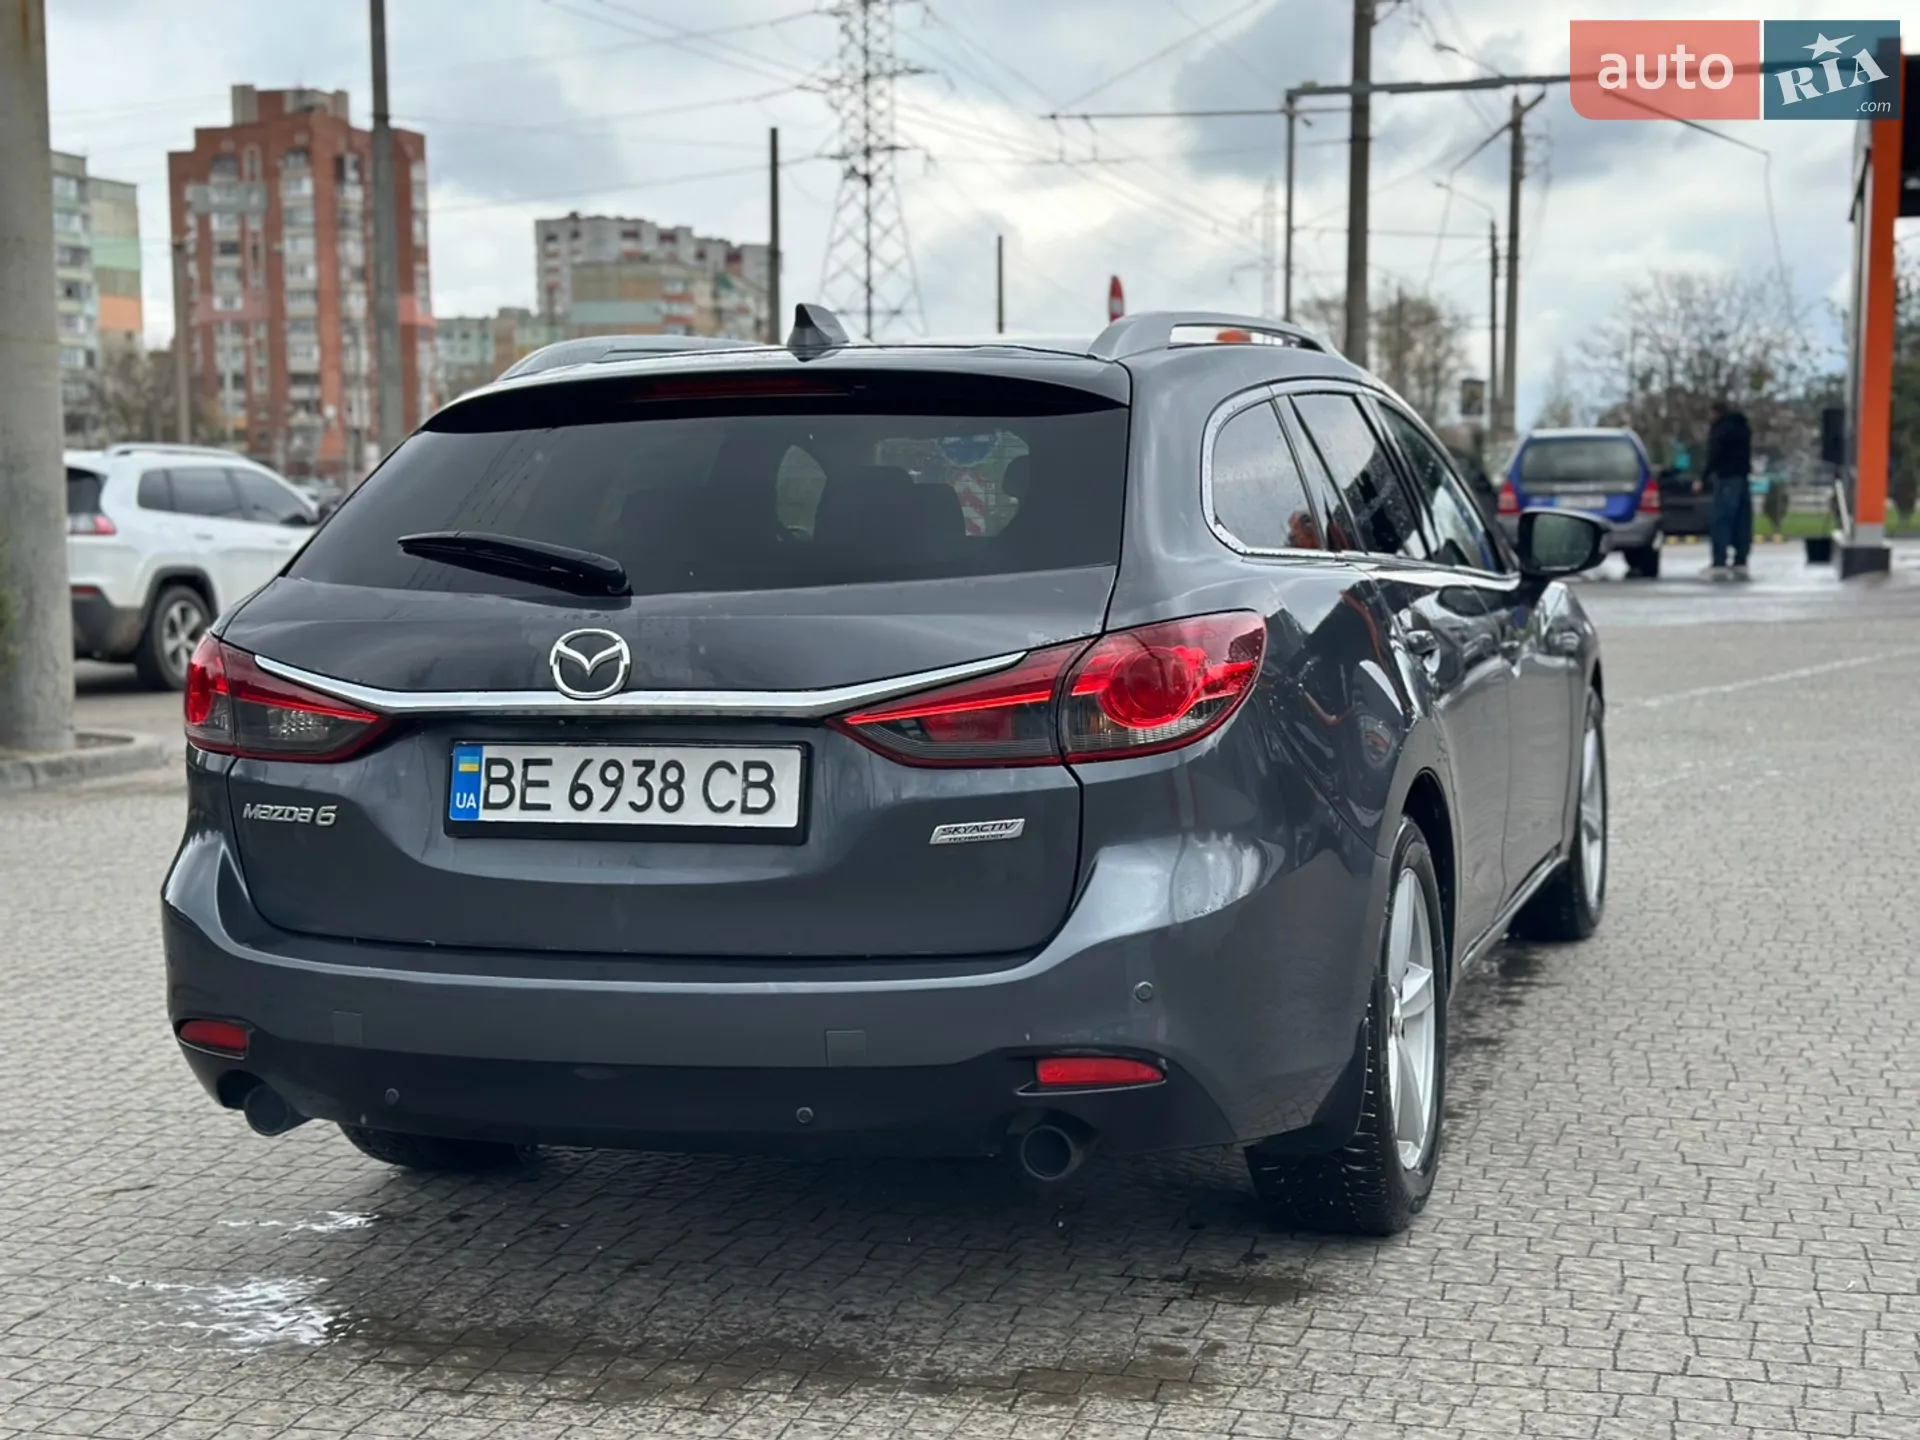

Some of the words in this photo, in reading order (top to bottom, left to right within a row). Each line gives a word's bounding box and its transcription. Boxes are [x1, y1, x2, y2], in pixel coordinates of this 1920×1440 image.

[482, 757, 553, 811] BE
[568, 758, 685, 813] 6938
[702, 760, 776, 815] CB
[456, 792, 477, 809] UA
[941, 822, 1015, 835] SKYACTIV
